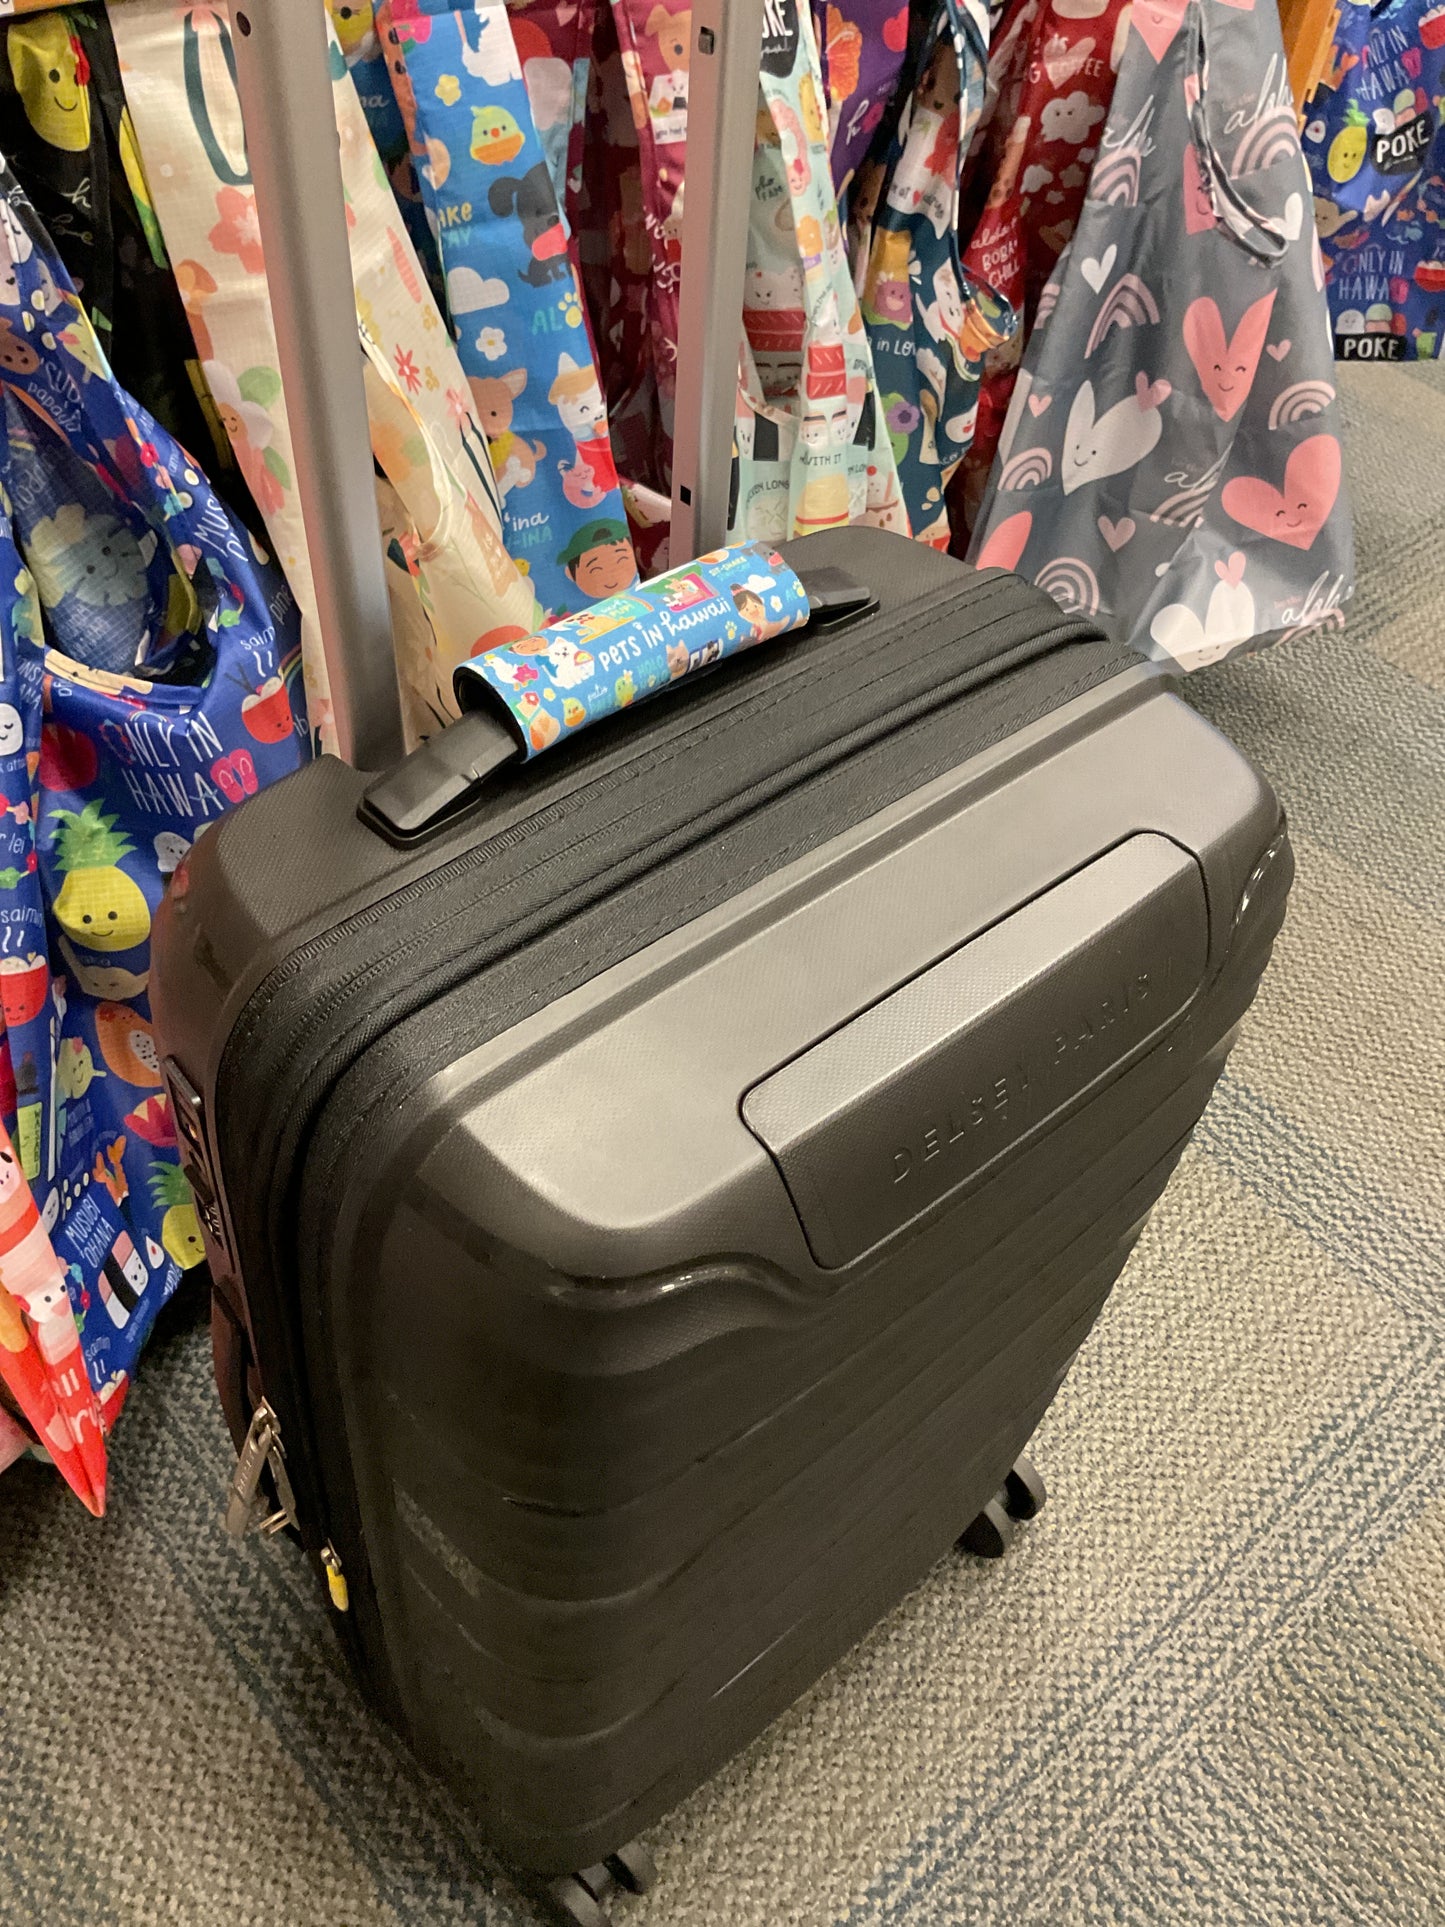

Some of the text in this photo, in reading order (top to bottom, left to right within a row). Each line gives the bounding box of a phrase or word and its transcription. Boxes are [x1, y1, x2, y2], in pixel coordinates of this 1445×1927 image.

[1376, 120, 1430, 163] POKE
[1343, 336, 1399, 360] POKE
[633, 622, 664, 649] IN
[659, 597, 731, 637] hawaii
[185, 711, 223, 762] IN
[64, 1193, 102, 1251] MUSUBI
